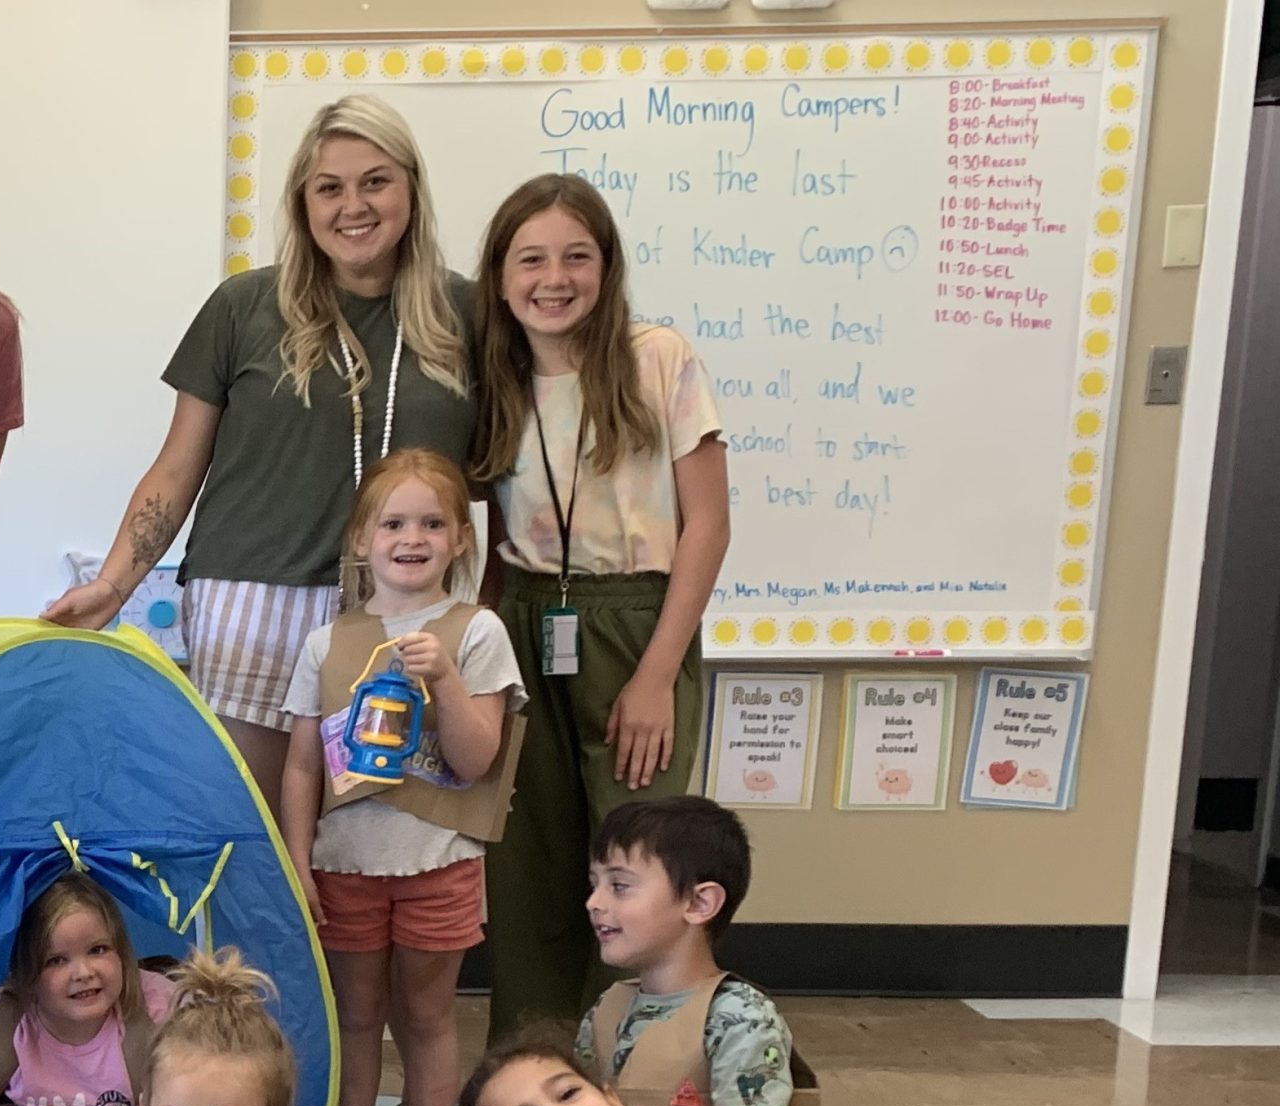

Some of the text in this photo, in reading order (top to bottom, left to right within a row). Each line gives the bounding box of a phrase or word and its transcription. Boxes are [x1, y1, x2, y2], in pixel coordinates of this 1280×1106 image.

[541, 83, 901, 158] Good Morning Campers!
[669, 168, 690, 193] is
[713, 149, 758, 196] the
[792, 149, 857, 196] last
[1032, 217, 1067, 233] Time
[636, 225, 874, 280] of Kinder Camp
[1026, 287, 1048, 308] Up
[694, 303, 744, 340] had
[764, 304, 811, 338] the
[832, 303, 885, 345] best
[1010, 312, 1052, 329] Home
[819, 362, 862, 403] and
[878, 383, 916, 407] we
[729, 423, 793, 454] school
[815, 427, 837, 459] to
[766, 475, 891, 539] best day!
[916, 581, 935, 592] and
[969, 580, 1007, 592] Natalie
[732, 686, 804, 706] Rule #3
[865, 687, 937, 706] Rule #4
[996, 678, 1069, 702] Rule #5
[740, 710, 796, 722] Raise your
[885, 716, 912, 725] Make
[1003, 707, 1052, 720] Keep our
[743, 724, 790, 734] hand for
[882, 730, 913, 740] smart
[993, 721, 1057, 737] class family
[729, 739, 801, 749] permission to
[1005, 736, 1041, 749] happy!
